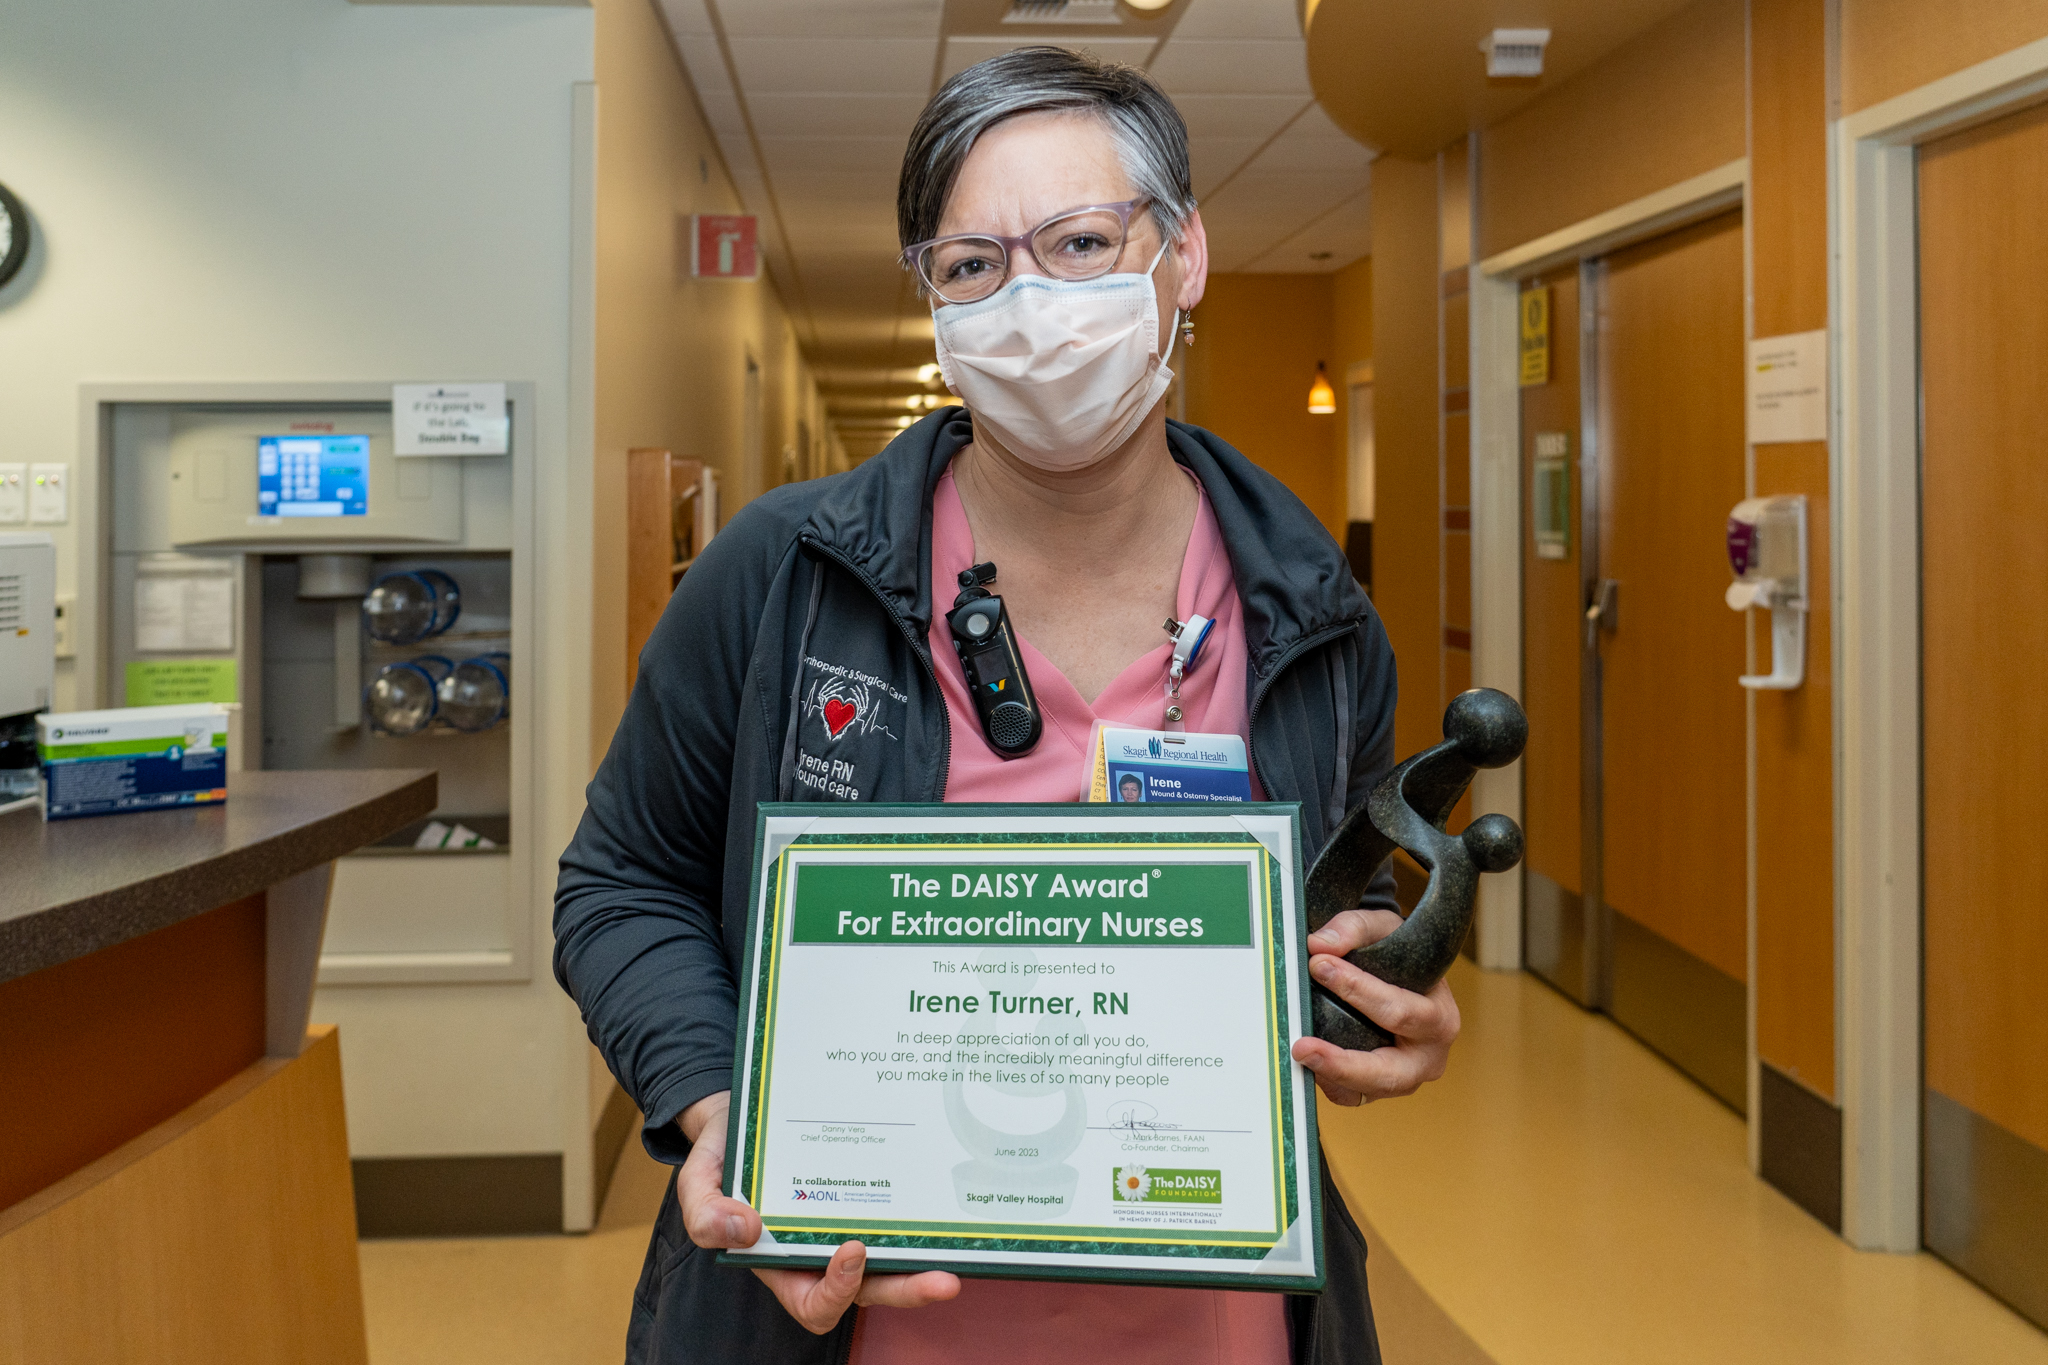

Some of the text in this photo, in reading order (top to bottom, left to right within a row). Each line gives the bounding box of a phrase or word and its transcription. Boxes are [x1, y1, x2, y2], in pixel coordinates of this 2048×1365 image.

[804, 653, 849, 677] rthopedic
[888, 686, 908, 703] Care
[1122, 746, 1228, 762] Skagit Regional Health
[800, 747, 855, 782] Irene RN
[1149, 776, 1182, 789] Irene
[828, 781, 859, 800] care
[1150, 790, 1175, 798] Wound
[1183, 792, 1209, 802] Ostomy
[1210, 794, 1242, 802] Specialist
[890, 872, 940, 898] The
[951, 873, 1038, 898] DAISY
[838, 910, 1204, 942] For Extraordinary Nurses
[932, 961, 1116, 976] This Award is presented to
[909, 990, 1129, 1018] Irene Turner, RN
[897, 1031, 1149, 1049] In deep appreciation of all you do,
[826, 1048, 1224, 1068] who you are, and the incredibly meaningful difference
[876, 1069, 1170, 1088] you make in the lives of so many people
[822, 1125, 846, 1134] Danny
[800, 1134, 886, 1144] Chief Operating Officer
[994, 1148, 1039, 1156] June 2023
[1170, 1144, 1210, 1152] Chairman
[805, 1178, 866, 1186] collaboration
[870, 1179, 891, 1188] with
[1154, 1176, 1217, 1189] The DAISY
[808, 1190, 840, 1202] AONL
[966, 1193, 1064, 1205] Skagit Valley Hospital
